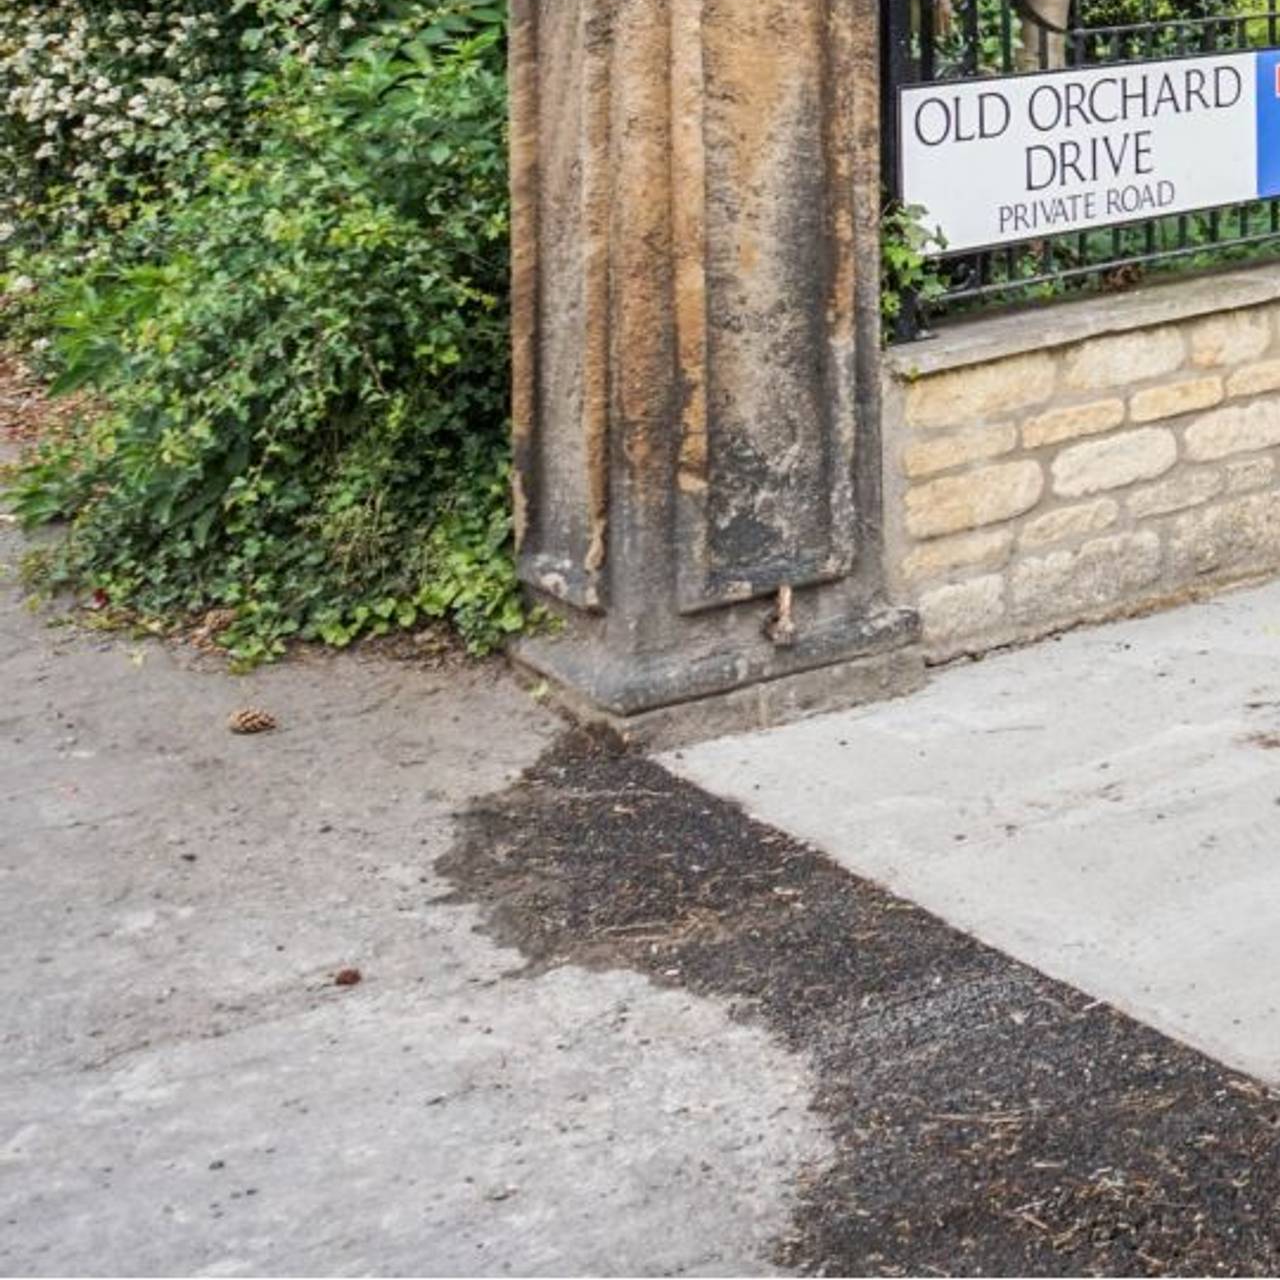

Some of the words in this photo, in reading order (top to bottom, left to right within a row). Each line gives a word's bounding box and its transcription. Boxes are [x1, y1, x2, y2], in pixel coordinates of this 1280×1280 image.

[914, 92, 1011, 146] OLD
[1028, 66, 1242, 132] ORCHARD
[1025, 131, 1153, 191] DRIVE
[999, 193, 1095, 233] PRIVATE
[1106, 180, 1175, 213] ROAD
